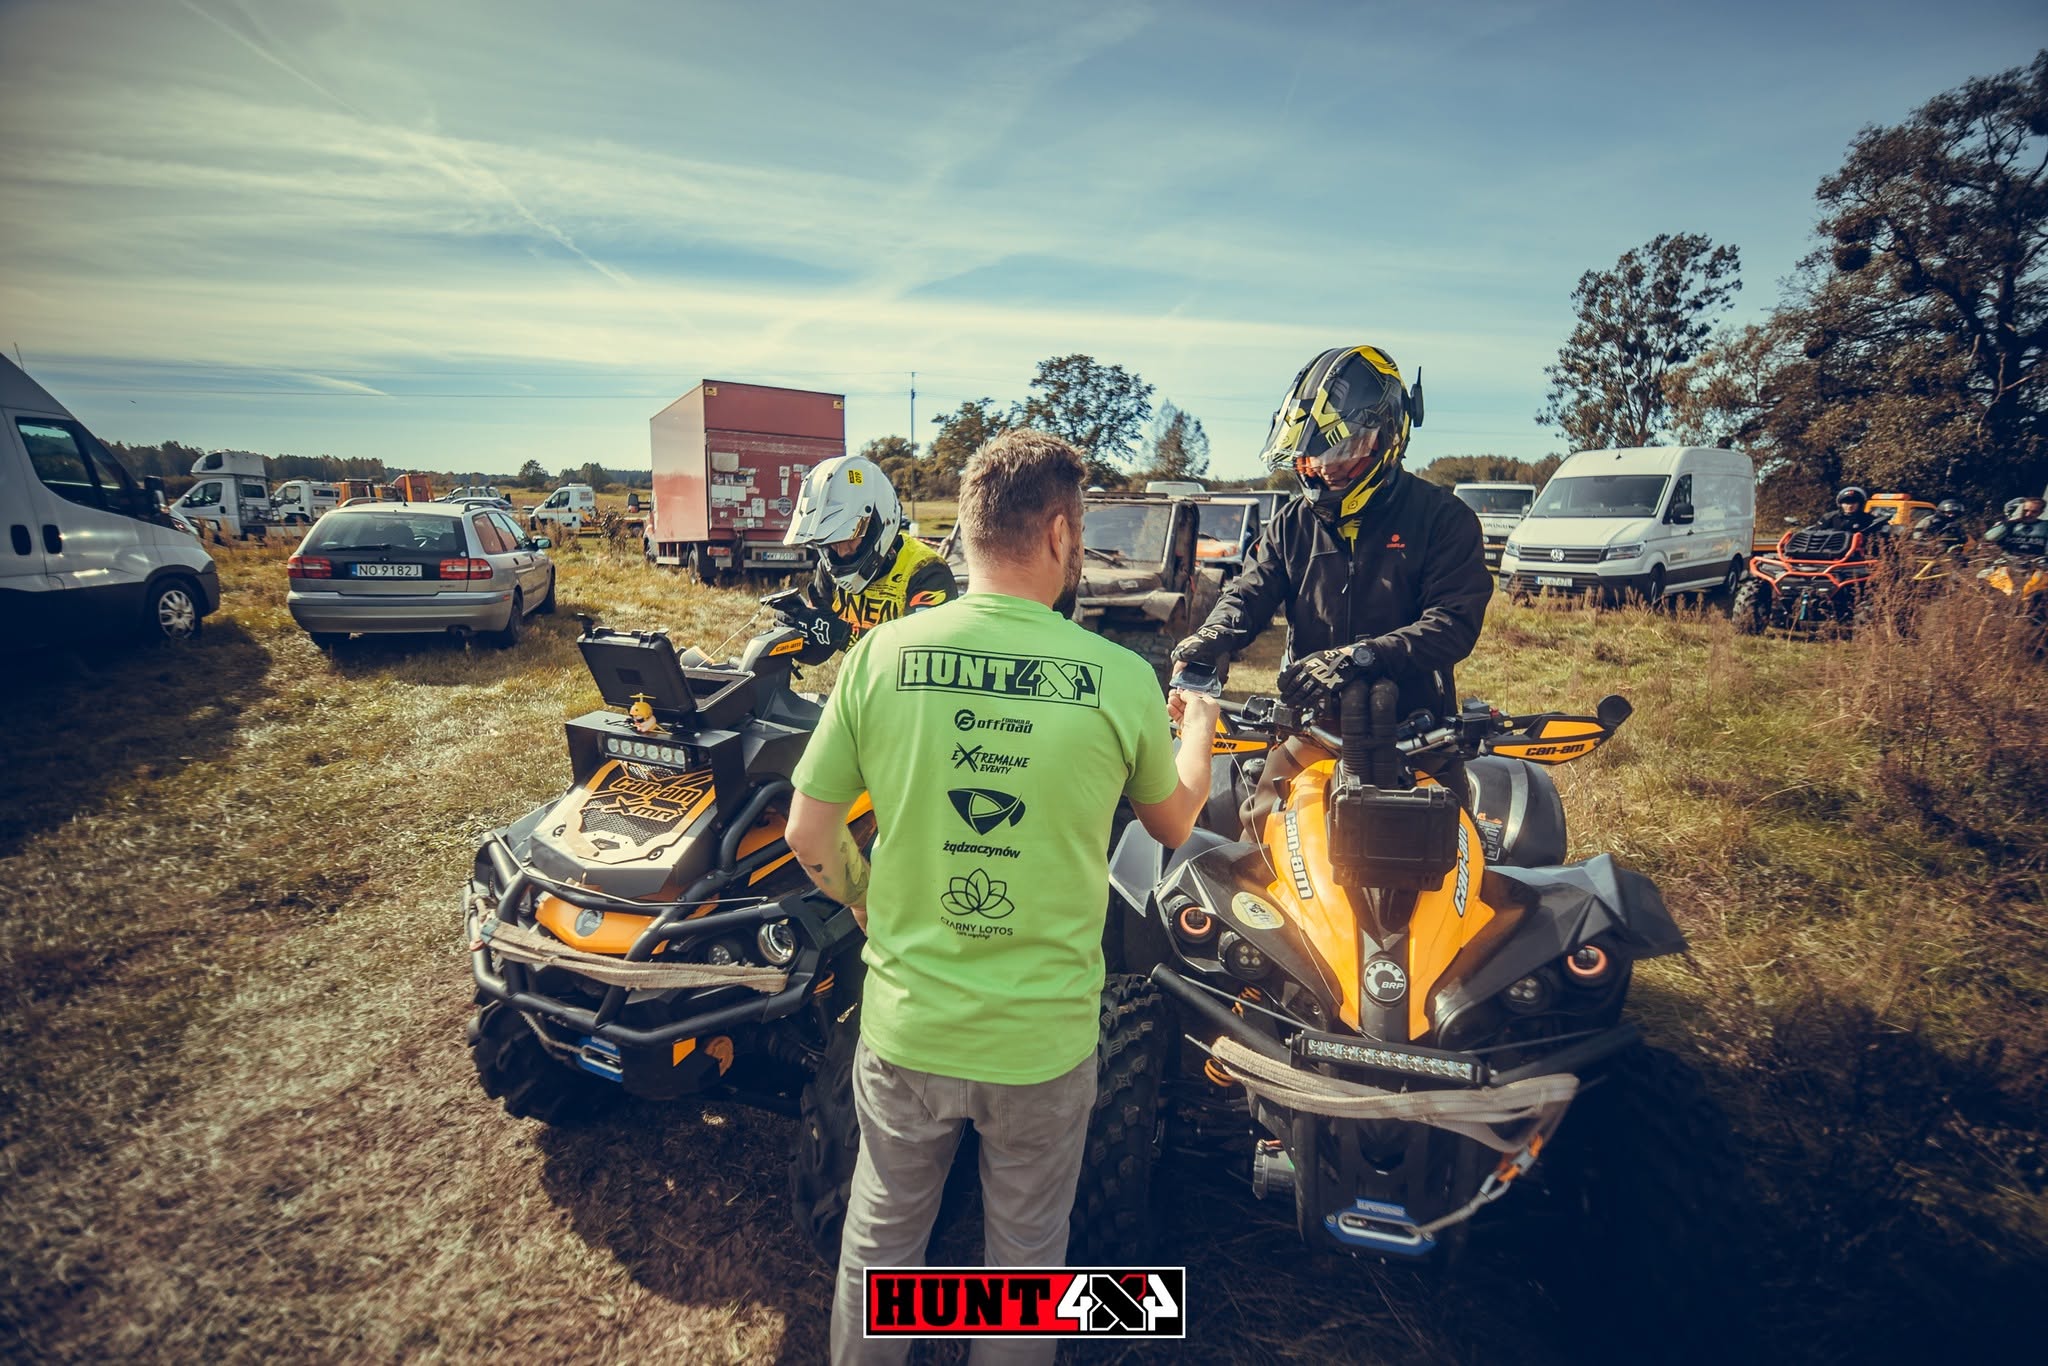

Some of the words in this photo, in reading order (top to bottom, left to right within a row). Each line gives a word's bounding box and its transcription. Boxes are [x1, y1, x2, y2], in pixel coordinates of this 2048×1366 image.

[360, 565, 378, 576] NO
[382, 565, 419, 576] 9182J
[976, 717, 1034, 734] offroad
[1525, 743, 1585, 756] can-am
[979, 764, 1011, 775] EVENTY
[609, 776, 703, 807] can-am
[943, 840, 1021, 859] żądzaczynów
[1284, 809, 1314, 900] can-am
[979, 925, 1014, 936] LOTOS
[1381, 981, 1404, 990] BRP
